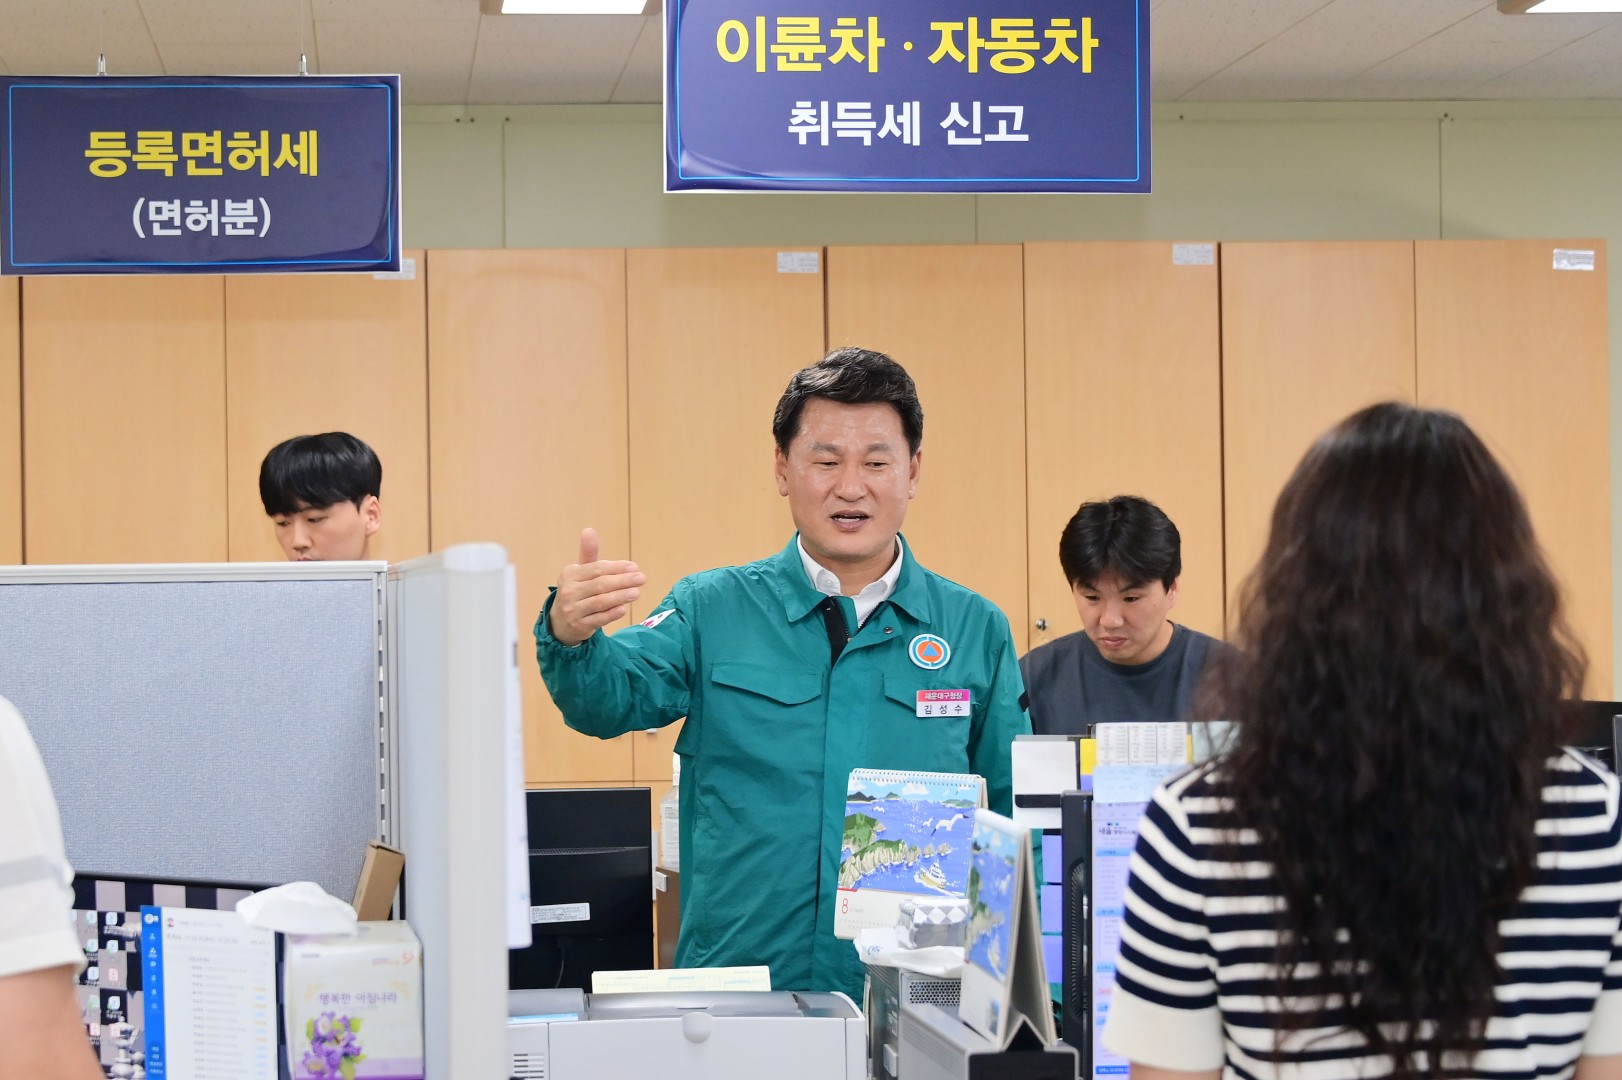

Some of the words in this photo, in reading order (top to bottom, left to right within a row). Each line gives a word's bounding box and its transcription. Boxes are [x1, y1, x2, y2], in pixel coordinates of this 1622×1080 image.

[717, 16, 886, 72] 이륜차
[929, 17, 1100, 74] 자동차
[788, 101, 920, 146] 취득세
[940, 102, 1029, 145] 신고
[84, 130, 318, 178] 등록면허세
[133, 198, 270, 238] (면허분)
[842, 898, 849, 914] 8
